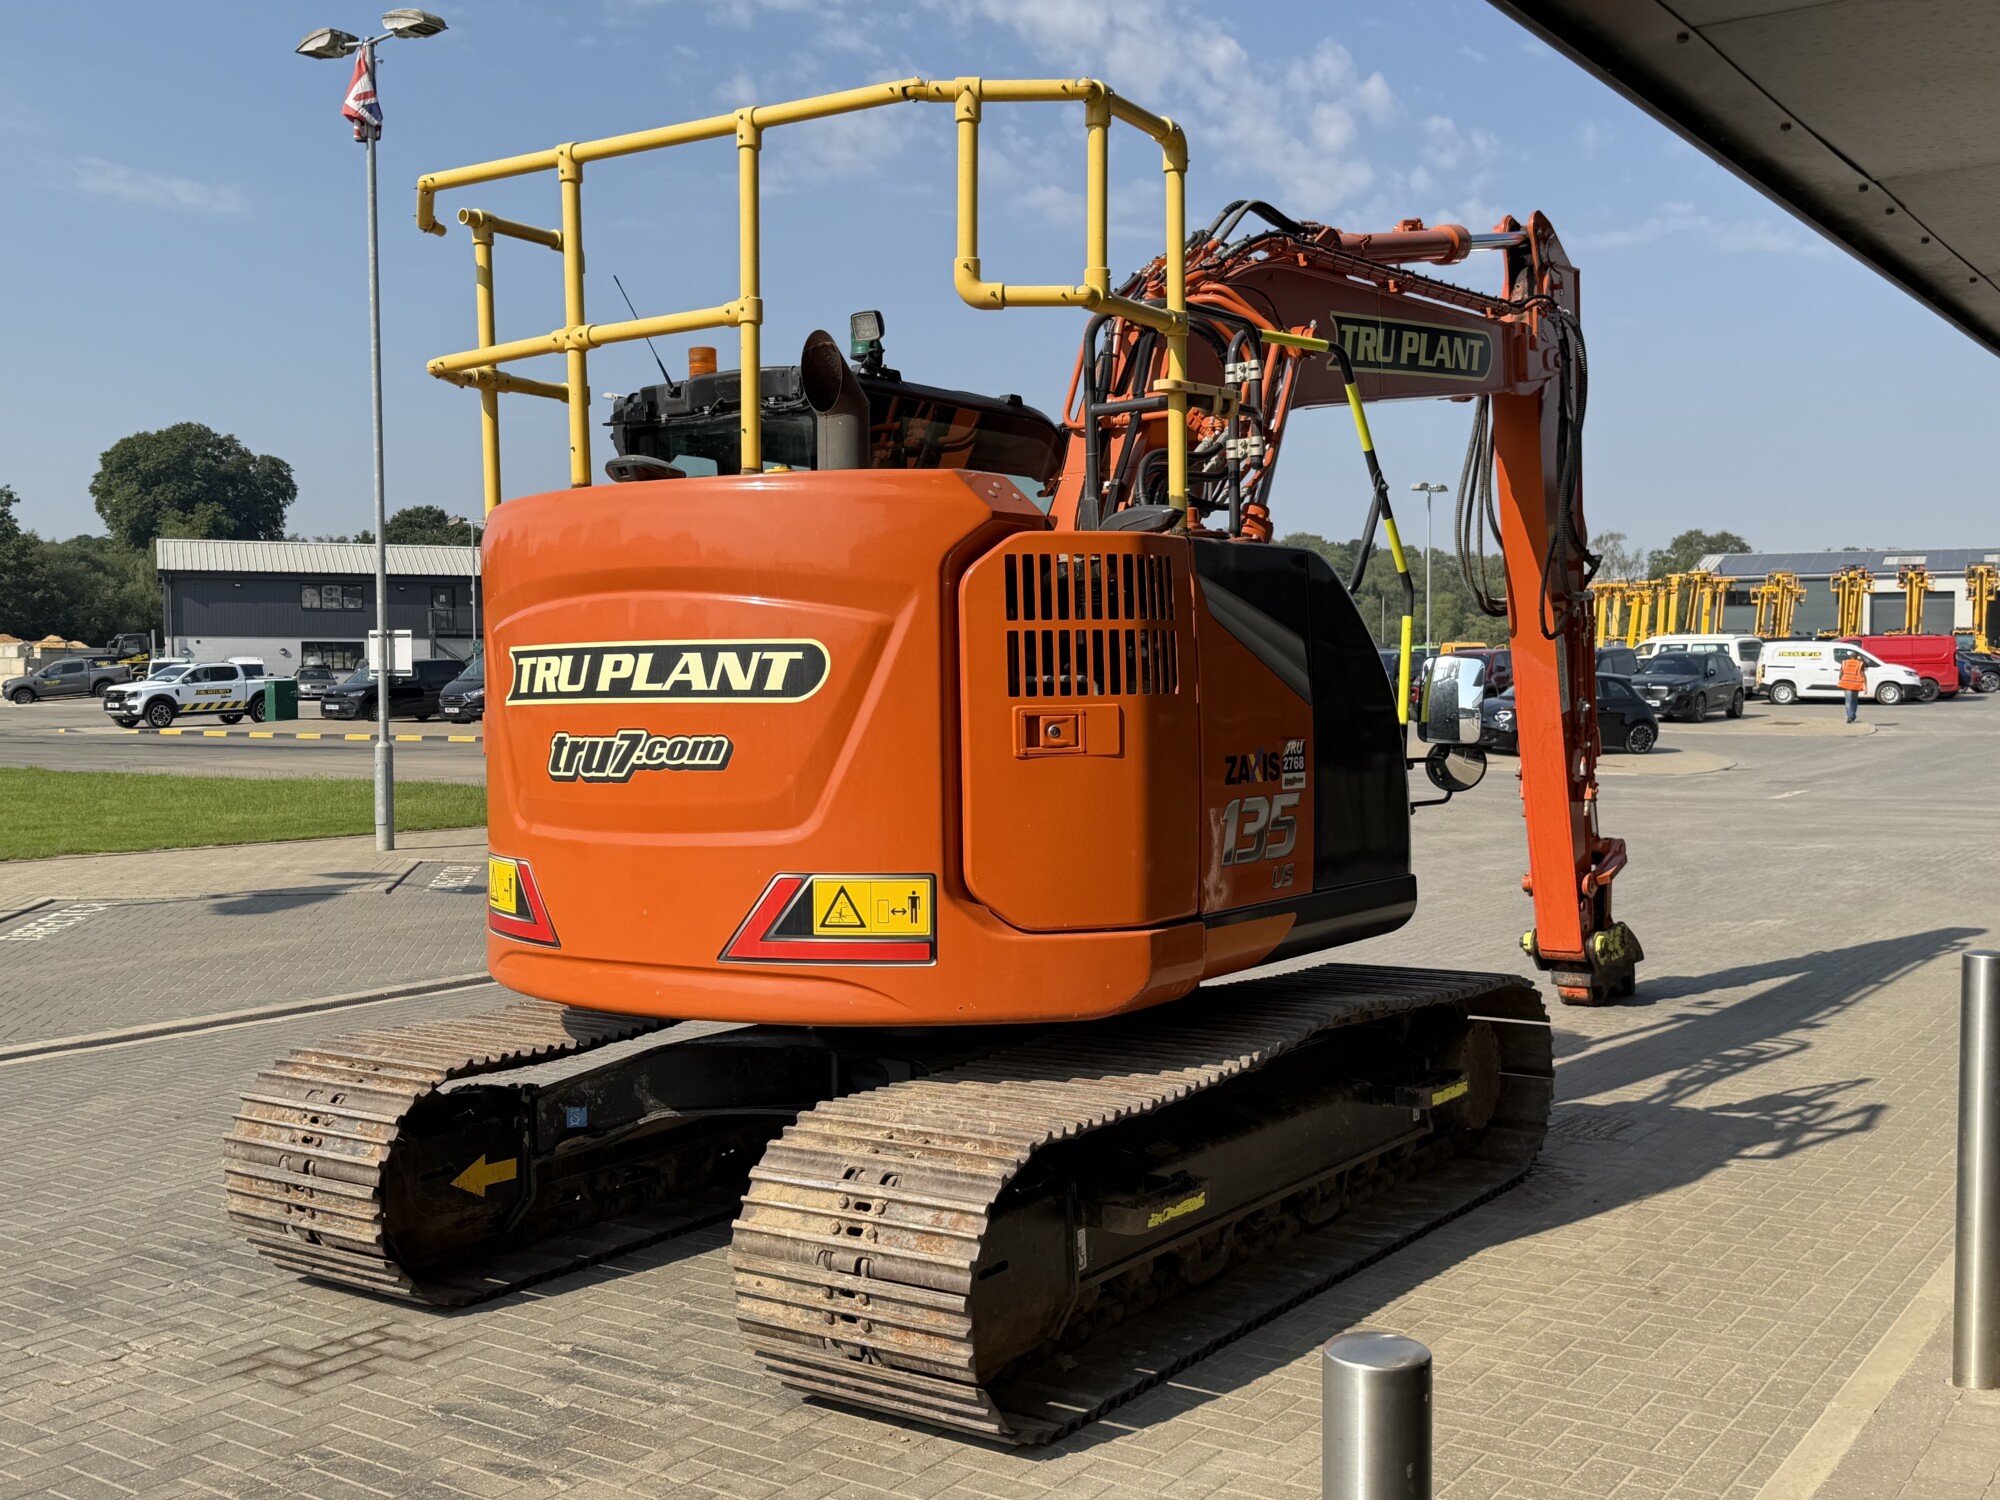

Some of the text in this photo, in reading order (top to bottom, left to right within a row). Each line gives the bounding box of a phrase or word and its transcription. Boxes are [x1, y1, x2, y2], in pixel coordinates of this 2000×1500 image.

[1340, 325, 1484, 371] TRU PLANT
[518, 652, 804, 694] TRU PLANT
[548, 729, 733, 782] tru7.com
[1225, 747, 1280, 785] ZAXIS
[1283, 756, 1304, 770] 2768
[1286, 740, 1303, 755] TRU
[1220, 793, 1301, 867] 135
[1272, 864, 1294, 888] US
